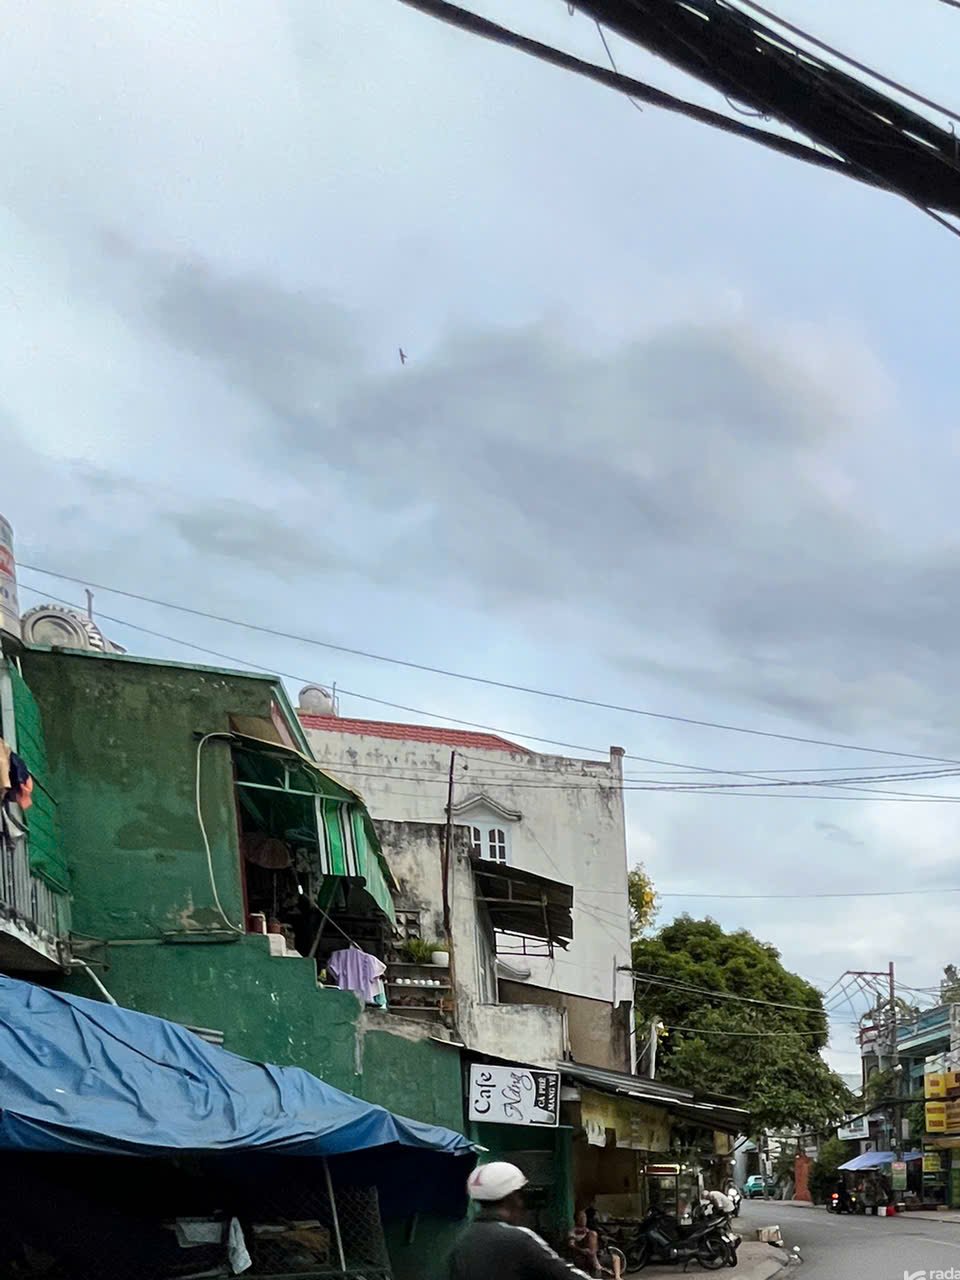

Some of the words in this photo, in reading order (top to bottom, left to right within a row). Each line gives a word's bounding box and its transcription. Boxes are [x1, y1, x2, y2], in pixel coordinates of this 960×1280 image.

[474, 1072, 496, 1114] Cafe
[537, 1077, 546, 1095] PHÊ
[547, 1088, 556, 1111] MANG
